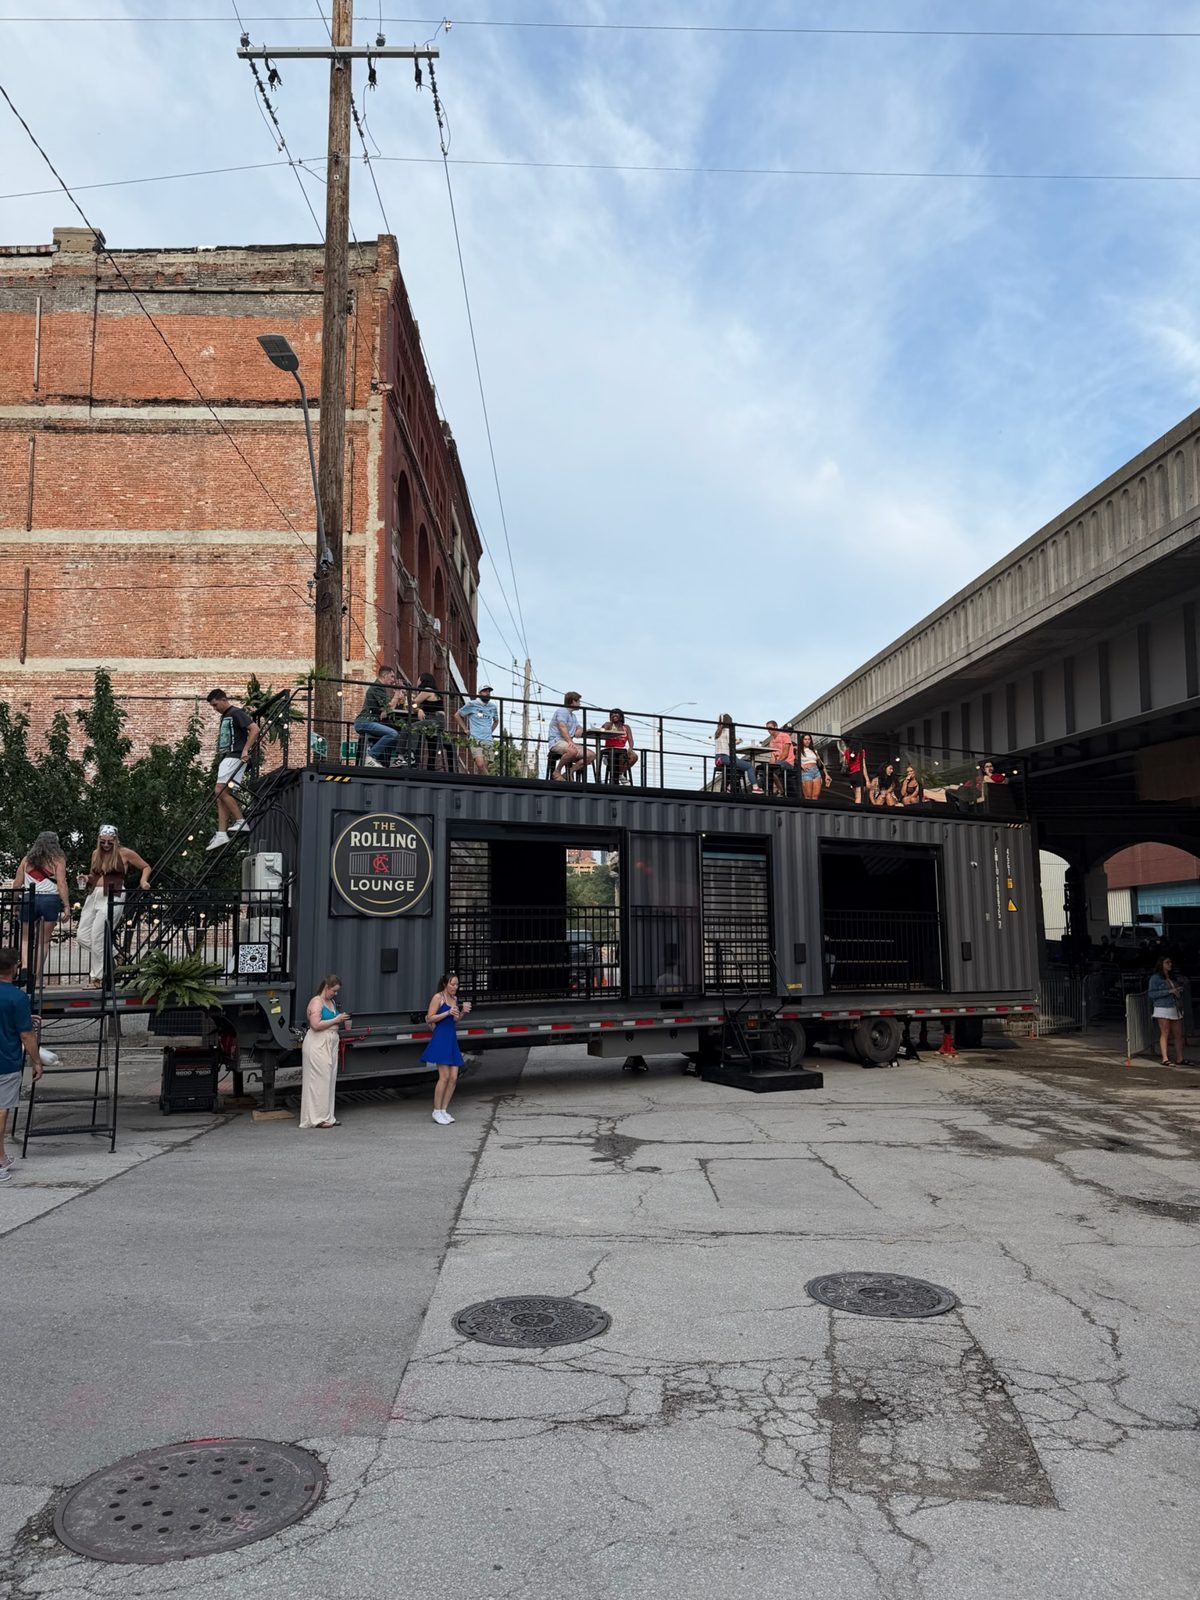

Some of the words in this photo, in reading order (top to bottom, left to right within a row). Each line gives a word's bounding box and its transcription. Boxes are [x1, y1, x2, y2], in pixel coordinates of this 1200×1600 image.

[373, 822, 395, 830] THE
[350, 832, 416, 848] ROLLING
[350, 880, 414, 891] LOUNGE
